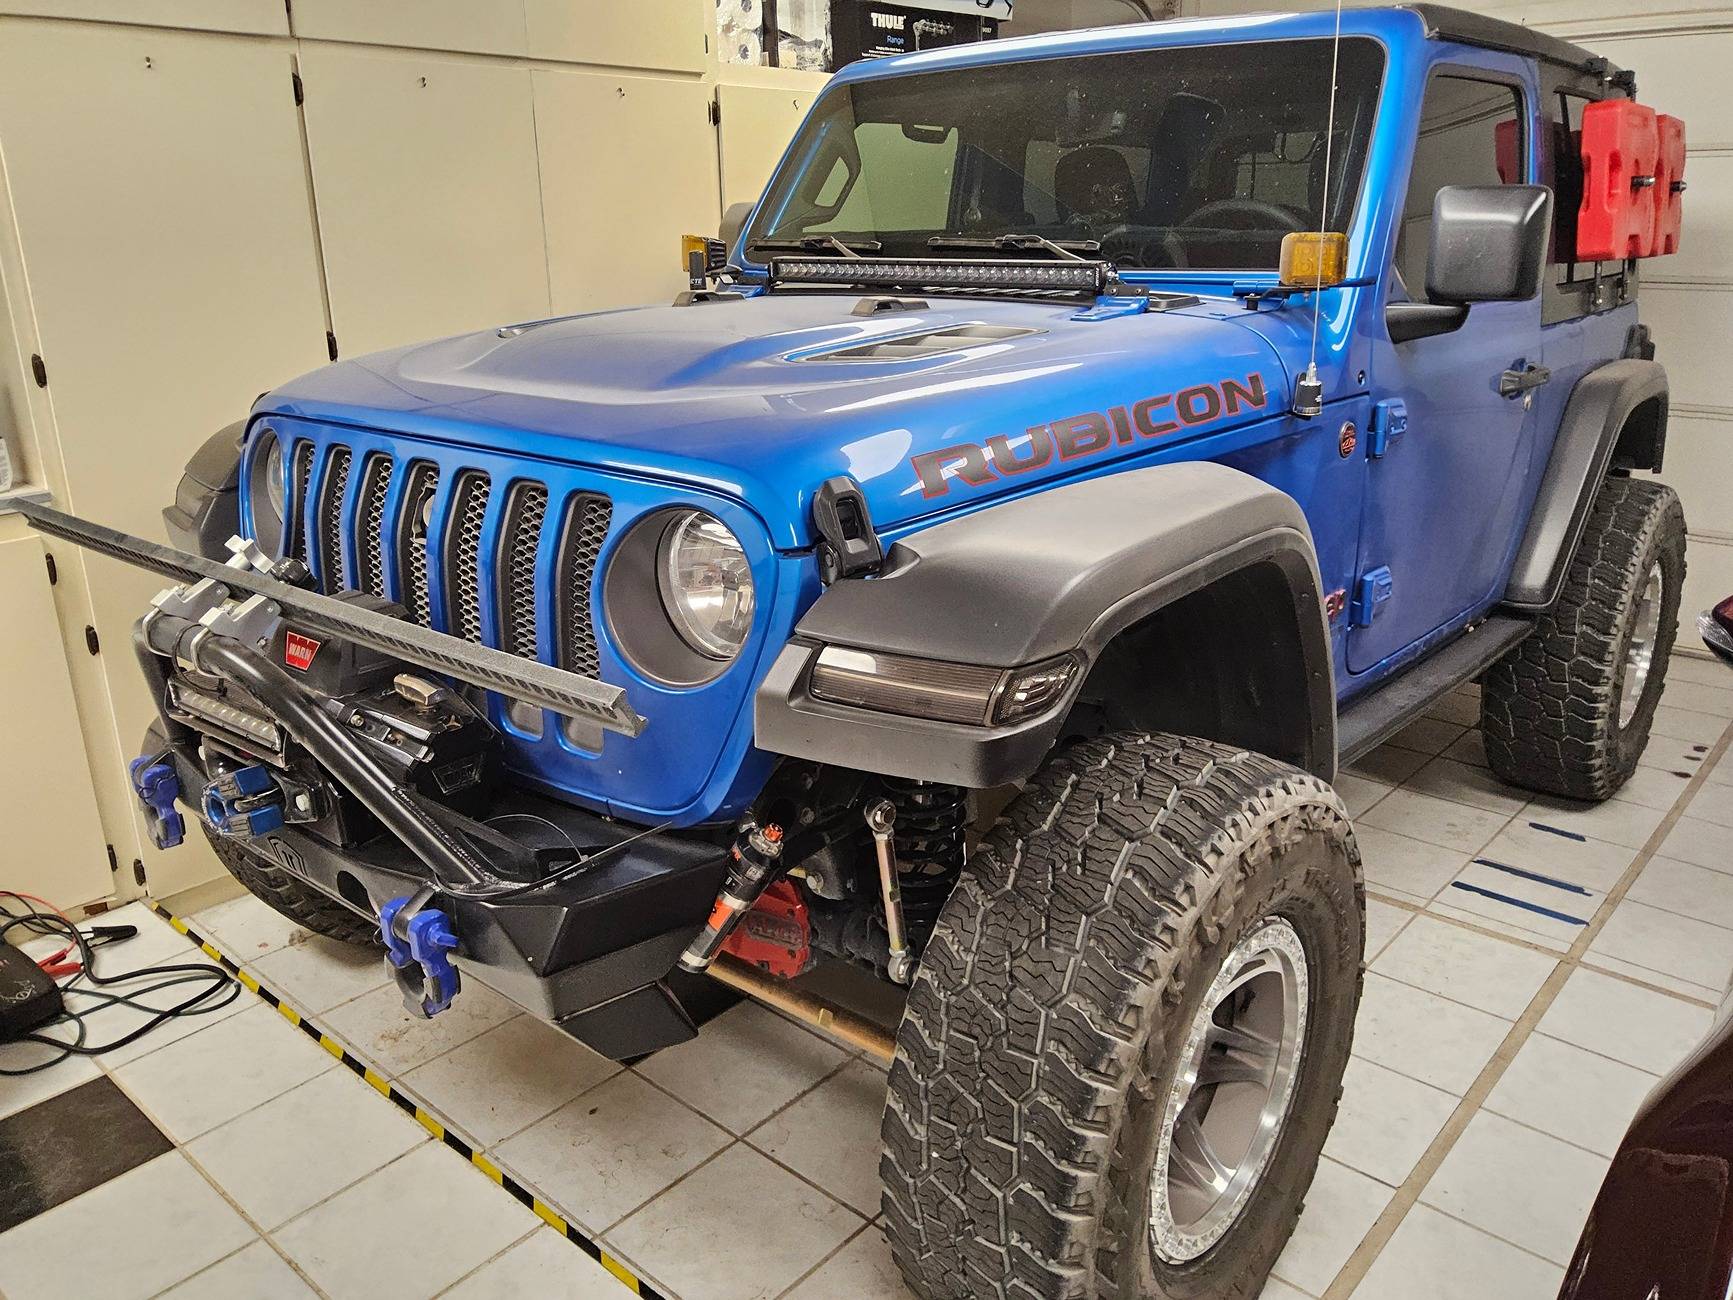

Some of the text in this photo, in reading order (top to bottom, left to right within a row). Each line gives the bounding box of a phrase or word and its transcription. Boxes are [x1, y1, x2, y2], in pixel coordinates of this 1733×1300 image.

[870, 12, 905, 30] THULE
[886, 35, 905, 45] Range
[912, 373, 1267, 499] RUBICON
[289, 642, 312, 661] WARN
